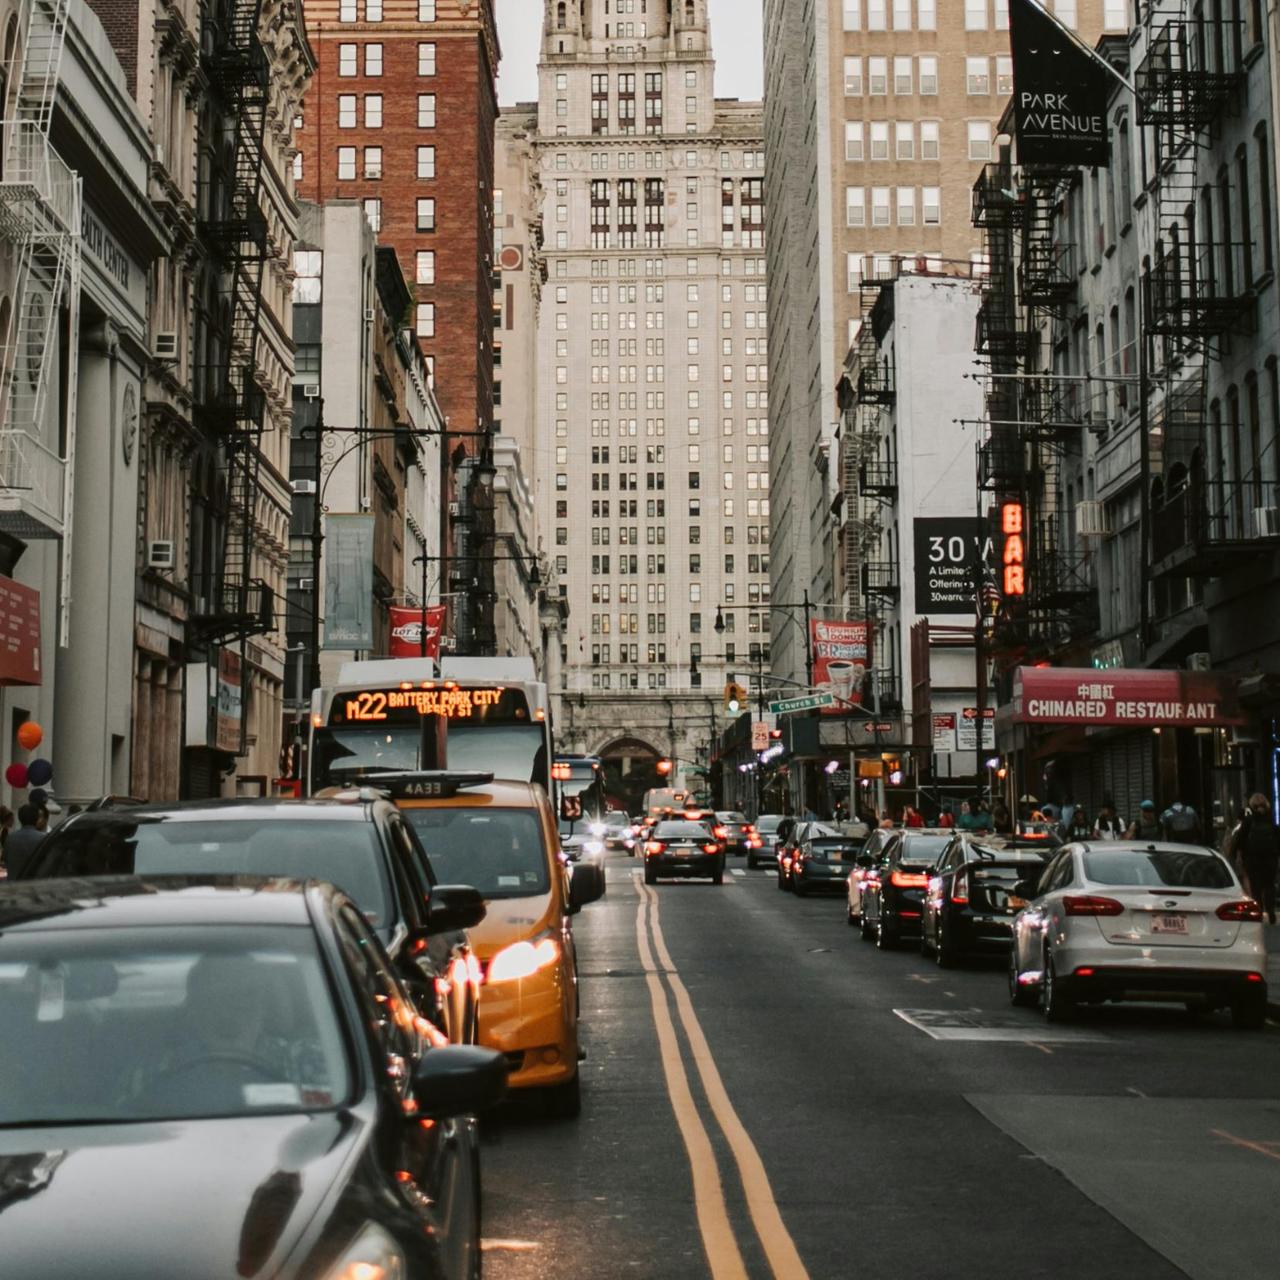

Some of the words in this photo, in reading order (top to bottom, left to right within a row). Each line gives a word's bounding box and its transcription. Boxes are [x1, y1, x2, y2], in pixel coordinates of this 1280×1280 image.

[1021, 92, 1071, 112] PARK
[1023, 113, 1102, 133] AVENUE
[81, 206, 103, 261] EALTH
[928, 536, 965, 562] 30
[1002, 503, 1025, 596] BAR
[928, 566, 937, 576] A
[929, 579, 966, 589] Offerin
[1077, 683, 1115, 700] 中國紅
[346, 693, 388, 720] M22
[388, 691, 438, 708] BATTERY
[441, 690, 471, 706] PARK
[473, 690, 502, 705] CITY
[458, 704, 473, 717] ST
[778, 699, 811, 711] Church
[814, 696, 825, 706] St
[1028, 700, 1107, 717] CHINARED
[1115, 701, 1217, 719] RESTAURANT
[755, 732, 767, 741] 25
[404, 782, 442, 795] 4A33
